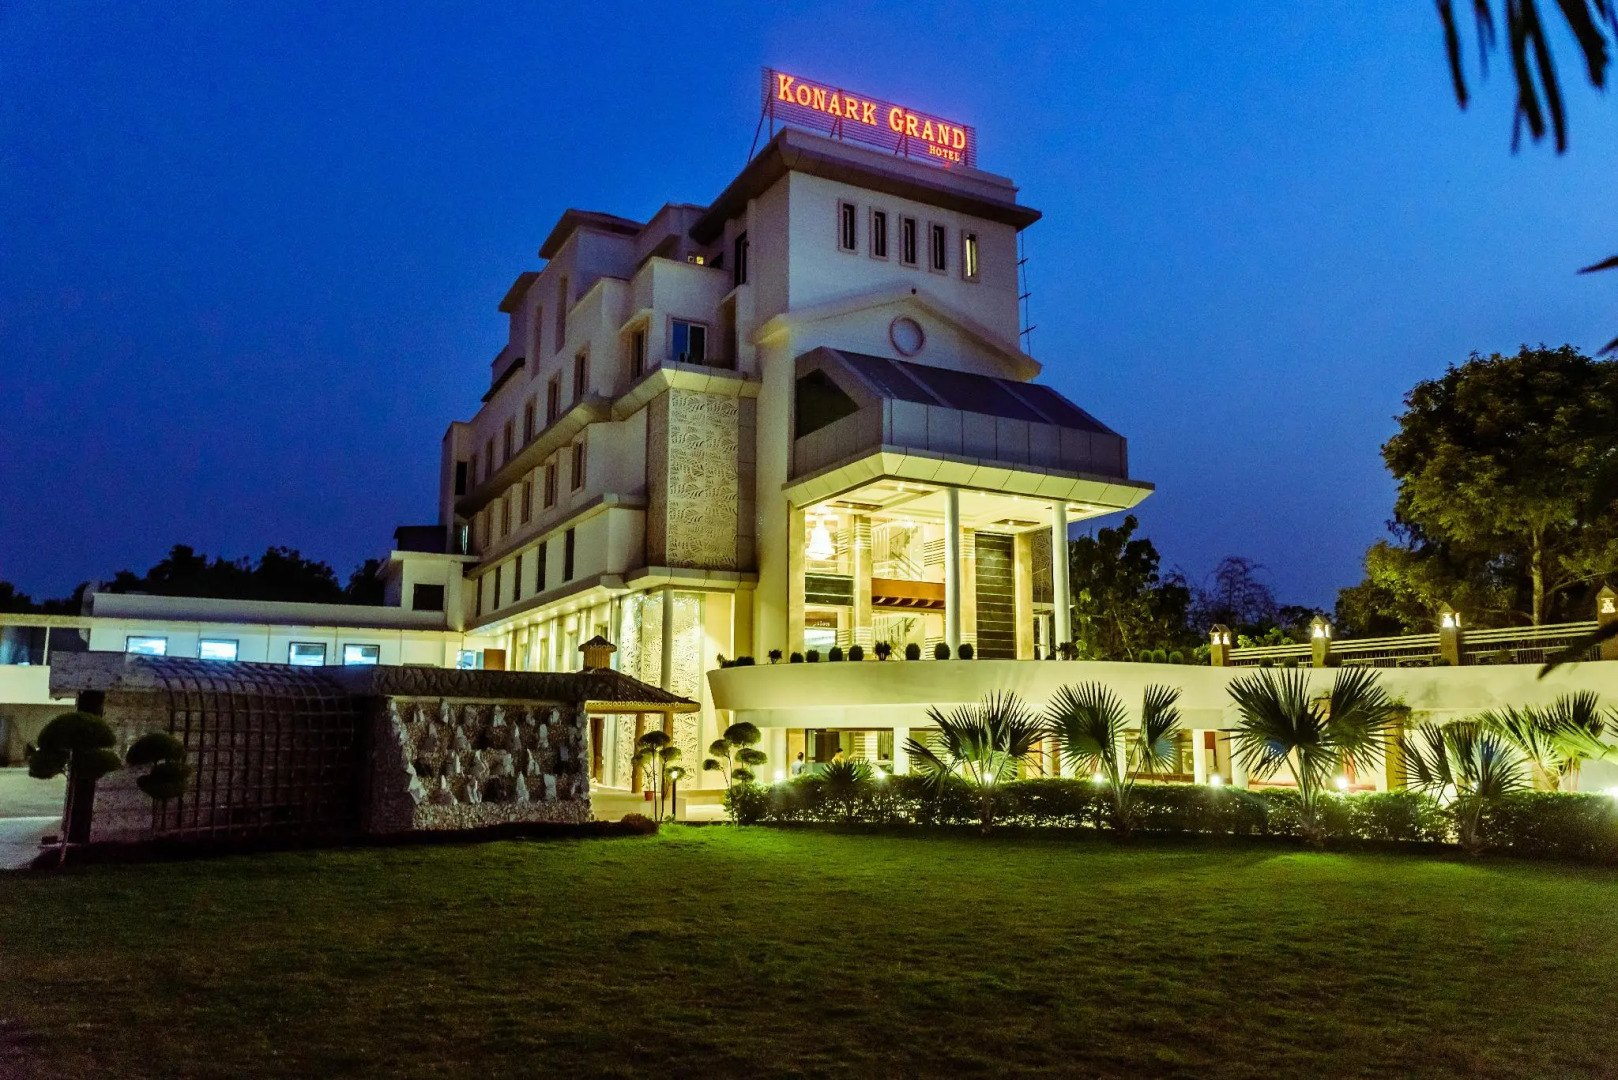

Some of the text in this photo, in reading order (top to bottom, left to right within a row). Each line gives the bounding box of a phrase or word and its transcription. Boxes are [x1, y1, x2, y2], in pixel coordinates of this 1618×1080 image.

[778, 73, 966, 149] KONARK GRAND
[929, 145, 960, 162] HOTEL
